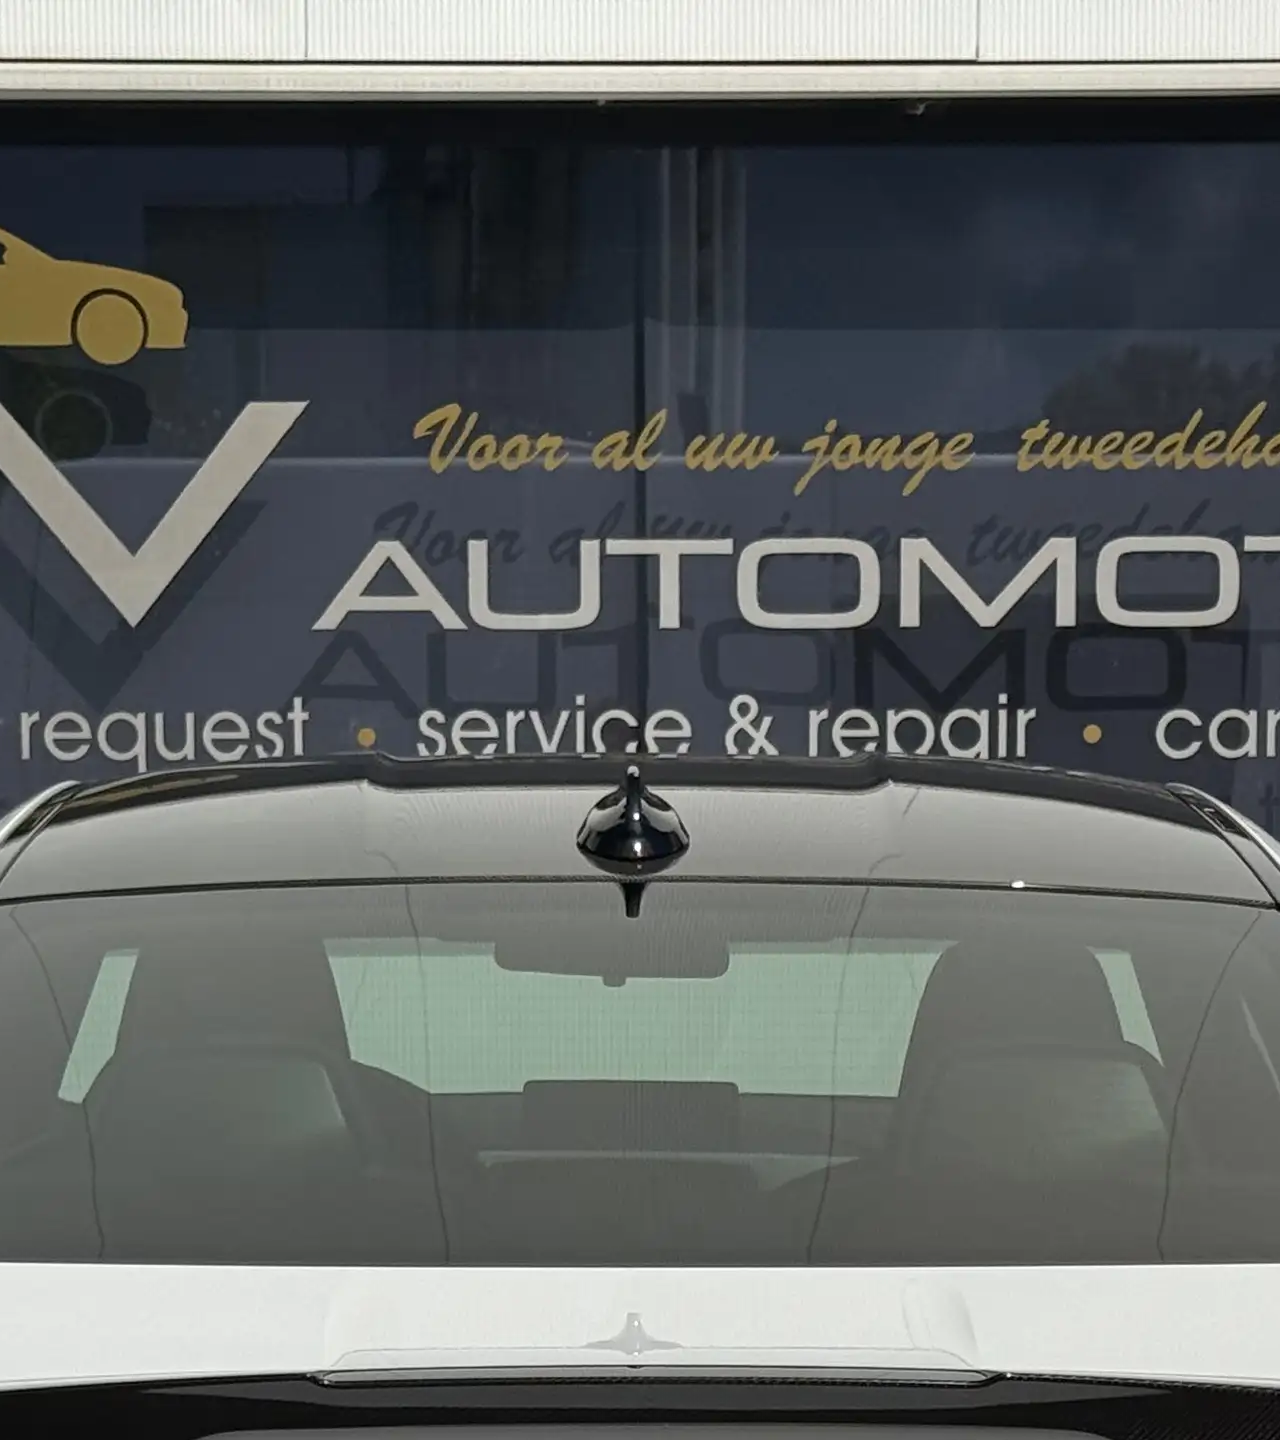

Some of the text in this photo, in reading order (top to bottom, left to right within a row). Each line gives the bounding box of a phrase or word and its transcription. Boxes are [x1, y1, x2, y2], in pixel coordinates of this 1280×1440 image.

[412, 403, 571, 475] Voor
[591, 408, 669, 472] al
[684, 429, 780, 472] uw
[793, 419, 975, 497] jonge
[19, 697, 310, 774] request
[416, 694, 693, 758] service
[724, 693, 780, 758] &
[807, 692, 1037, 760] repair
